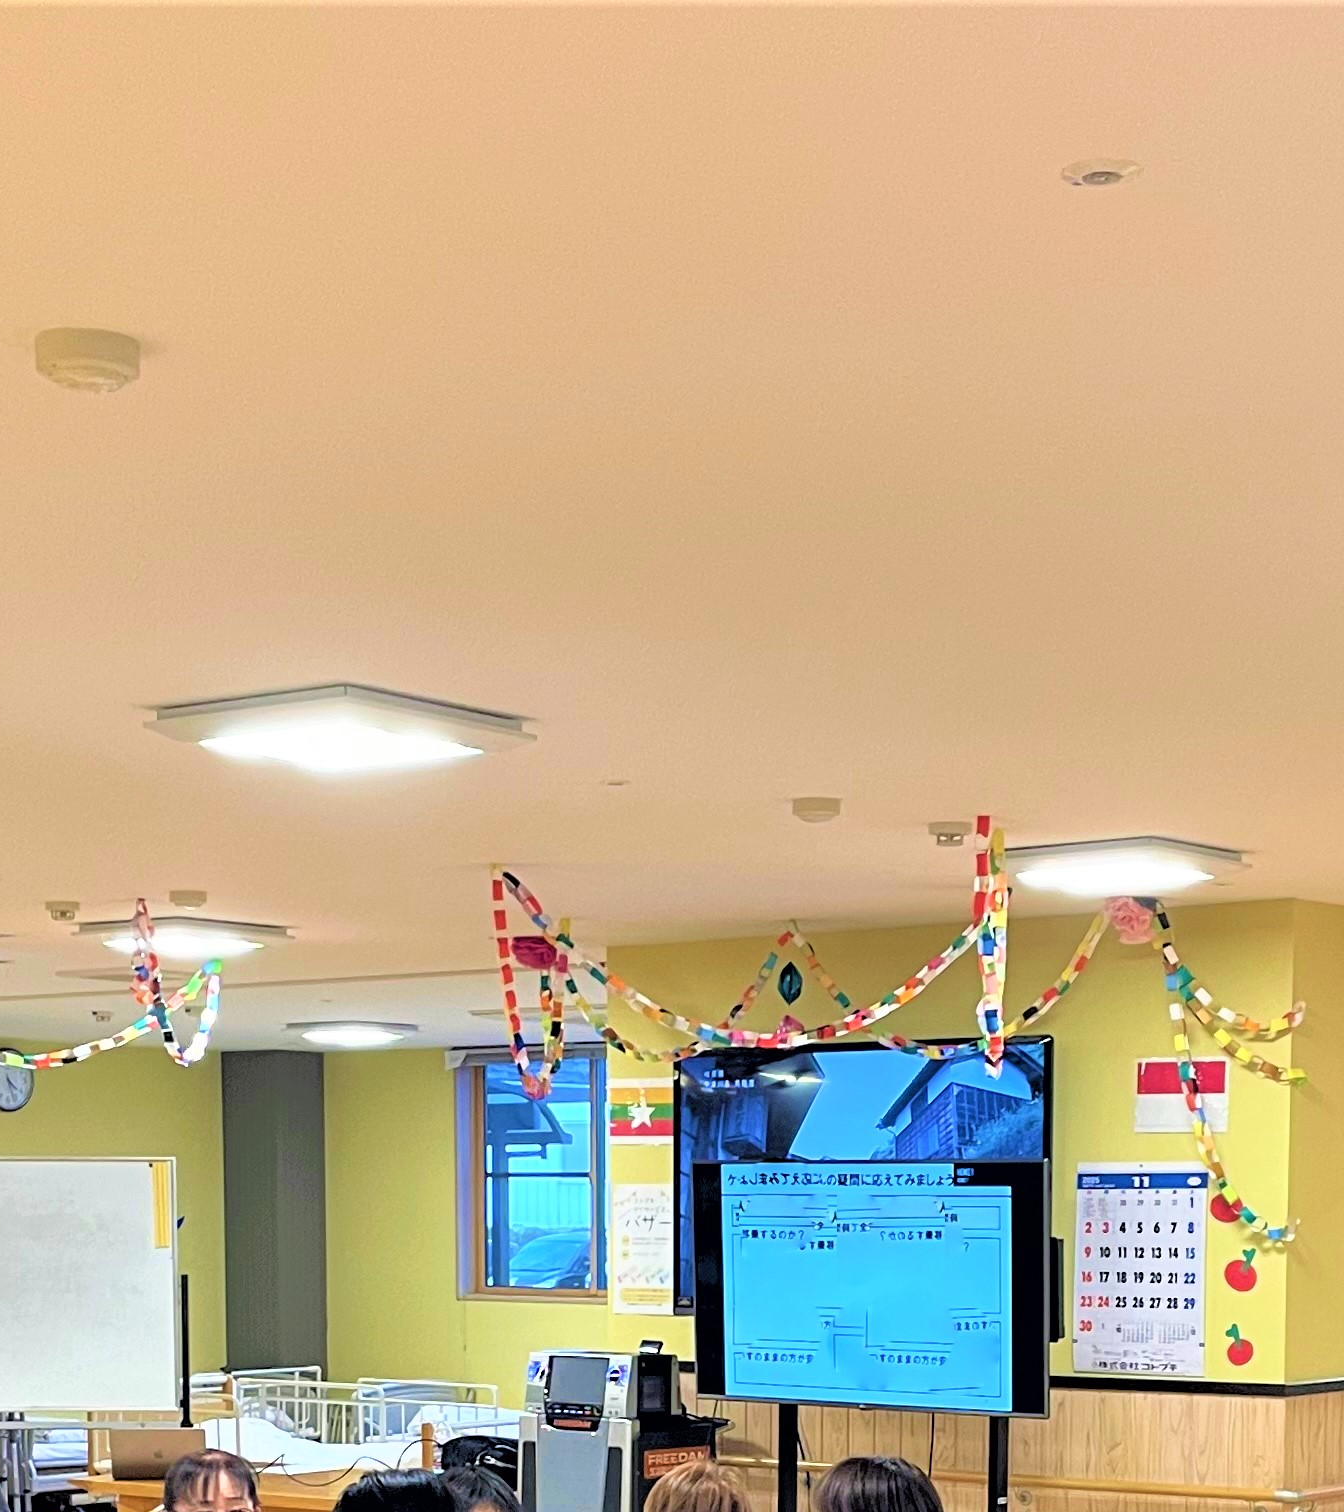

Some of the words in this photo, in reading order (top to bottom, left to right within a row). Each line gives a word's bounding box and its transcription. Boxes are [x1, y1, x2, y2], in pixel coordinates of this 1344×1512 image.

[1132, 1176, 1150, 1188] 11
[1085, 1222, 1092, 1233] 2
[1102, 1222, 1110, 1233] 3
[1119, 1222, 1126, 1233] 4
[1137, 1222, 1143, 1233] 5
[1153, 1222, 1160, 1233] 6
[1170, 1222, 1177, 1233] 7
[1187, 1222, 1194, 1233] 8
[1084, 1246, 1092, 1258] 9
[1099, 1247, 1111, 1258] 10
[1118, 1247, 1127, 1258] 11
[1134, 1247, 1144, 1258] 12
[1152, 1247, 1162, 1258] 13
[1169, 1247, 1178, 1258] 14
[1186, 1247, 1195, 1259] 15
[1081, 1271, 1092, 1282] 16
[1099, 1272, 1110, 1283] 17
[1116, 1272, 1127, 1283] 18
[1134, 1272, 1144, 1283] 19
[1150, 1272, 1162, 1283] 20
[1168, 1272, 1178, 1284] 21
[1184, 1272, 1196, 1284] 22
[1080, 1296, 1092, 1307] 23
[1098, 1296, 1109, 1307] 24
[1115, 1296, 1127, 1308] 25
[1132, 1296, 1144, 1308] 26
[1149, 1297, 1161, 1308] 27
[1167, 1297, 1178, 1309] 28
[1184, 1298, 1196, 1309] 29
[1079, 1320, 1092, 1332] 30
